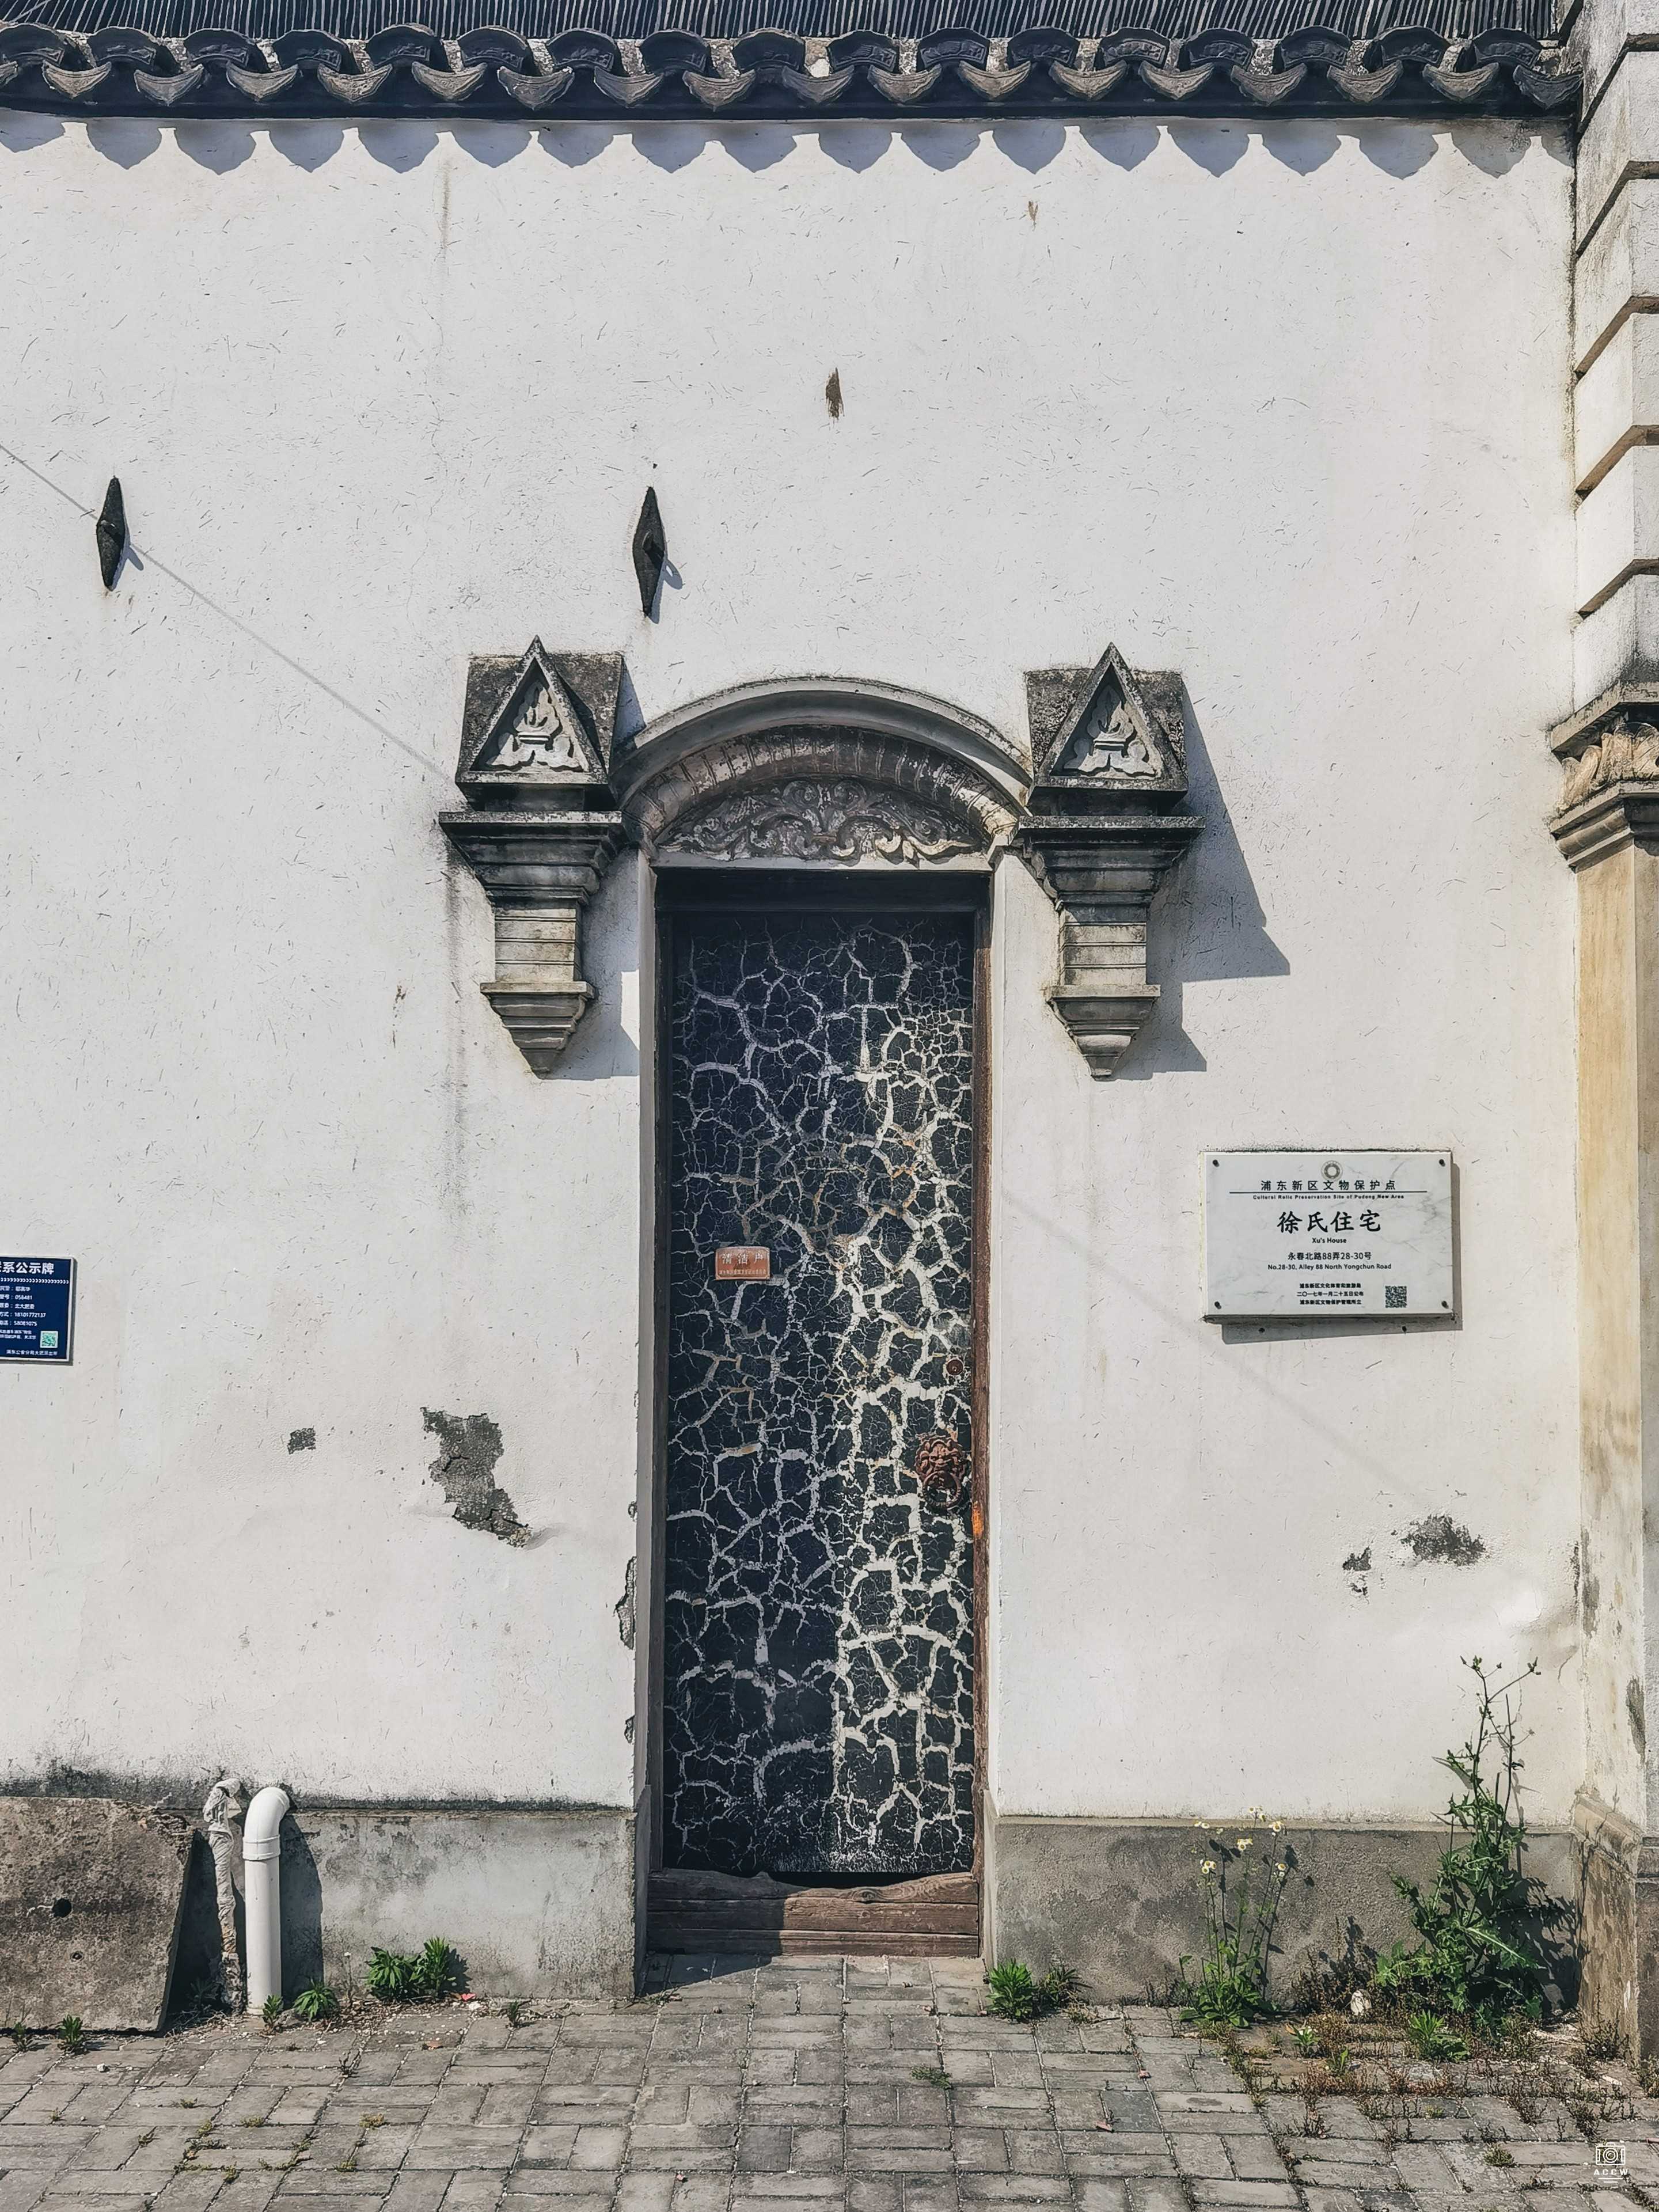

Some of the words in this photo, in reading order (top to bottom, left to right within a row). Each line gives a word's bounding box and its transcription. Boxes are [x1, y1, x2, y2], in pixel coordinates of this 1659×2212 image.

[1261, 1180, 1396, 1190] 浦东新区文物保护点
[1277, 1209, 1381, 1234] 徐氏住宅
[1288, 1251, 1372, 1260] 永春北路88弄28-30号
